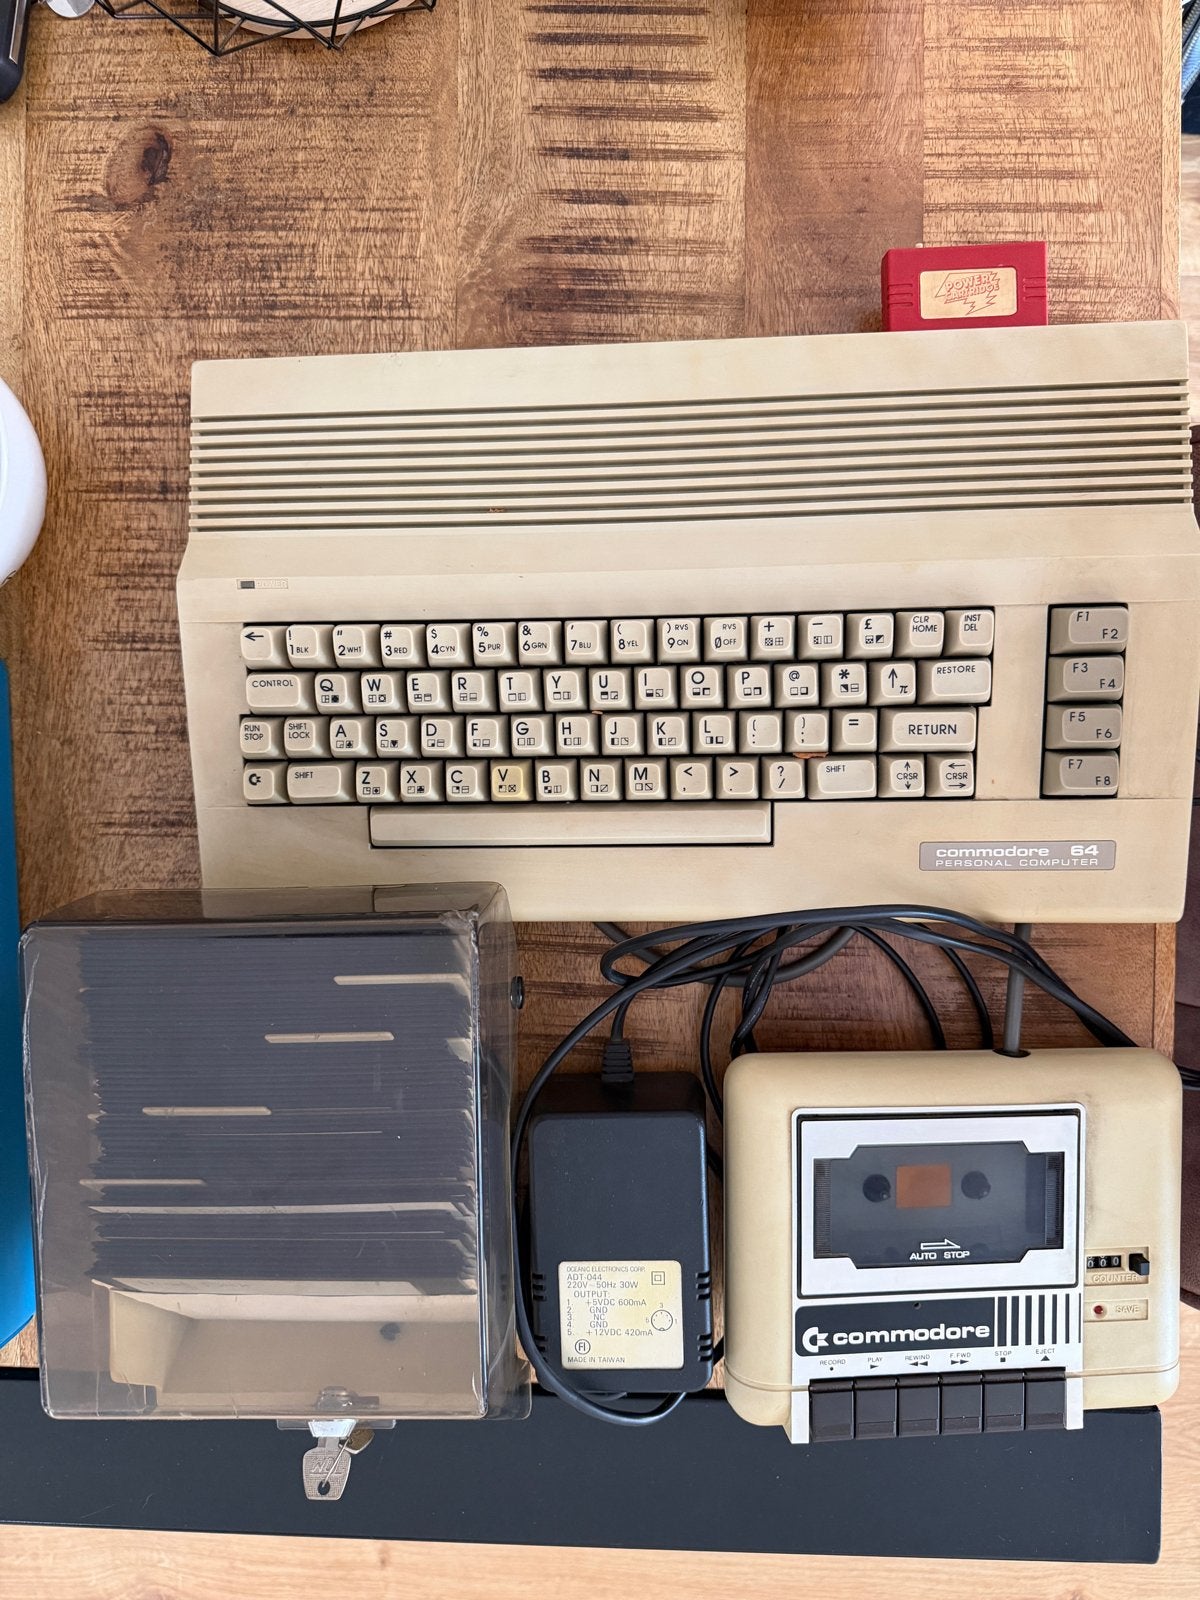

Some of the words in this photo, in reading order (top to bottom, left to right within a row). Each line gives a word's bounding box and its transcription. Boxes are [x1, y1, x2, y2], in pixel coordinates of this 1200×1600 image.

[945, 274, 990, 292] POWER
[913, 615, 930, 624] CLR
[964, 614, 981, 622] INST
[1076, 611, 1090, 622] F1
[674, 623, 689, 631] RVS
[722, 623, 737, 631] RVS
[864, 618, 872, 630] £
[912, 624, 938, 633] HOME
[964, 623, 978, 632] DEL
[383, 630, 393, 639] #
[431, 628, 438, 640] $
[477, 626, 489, 637] %
[522, 625, 532, 636] &
[1102, 628, 1119, 640] F2
[478, 642, 486, 653] 5
[487, 643, 501, 651] PUR
[522, 640, 531, 651] 6
[570, 640, 578, 651] 7
[579, 641, 592, 649] BLU
[618, 638, 626, 650] 8
[667, 637, 675, 648] 9
[723, 638, 737, 646] OFF
[289, 645, 294, 655] 1
[296, 646, 309, 654] BLK
[338, 645, 346, 656] 2
[346, 645, 362, 653] WHT
[385, 645, 393, 656] 3
[431, 644, 440, 655] 4
[936, 665, 976, 675] RESTORE
[1072, 662, 1089, 673] F3
[551, 675, 562, 688] Y
[598, 675, 608, 688] U
[691, 671, 705, 685] O
[741, 671, 750, 685] P
[788, 670, 801, 682] @
[251, 679, 294, 688] CONTROL
[319, 678, 334, 692] Q
[366, 678, 382, 691] W
[411, 678, 419, 691] E
[457, 677, 467, 690] R
[506, 677, 514, 690] T
[1099, 678, 1116, 689] F4
[1069, 711, 1086, 722] F5
[244, 724, 261, 733] RUN
[288, 722, 307, 731] SHIFT
[335, 724, 347, 738] A
[379, 723, 388, 737] S
[425, 723, 437, 737] D
[471, 722, 479, 736] F
[515, 721, 529, 735] G
[561, 721, 572, 735] H
[609, 721, 617, 735] J
[656, 721, 667, 735] K
[704, 720, 711, 733] L
[908, 724, 957, 736] RETURN
[244, 732, 264, 741] STOP
[288, 731, 310, 739] LOCK
[1096, 728, 1113, 739] F6
[825, 765, 846, 773] SHIFT
[1068, 759, 1083, 770] F7
[294, 771, 314, 779] SHIFT
[450, 769, 463, 784] C
[497, 768, 509, 782] V
[541, 770, 551, 783] B
[589, 768, 600, 782] N
[633, 767, 648, 780] M
[777, 765, 785, 777] ?
[896, 772, 919, 781] CRSR
[945, 772, 968, 780] CRSR
[361, 771, 371, 785] Z
[406, 770, 417, 784] X
[1095, 776, 1111, 786] F8
[936, 845, 1050, 858] commodore
[1070, 844, 1099, 856] 64
[935, 857, 1012, 867] PERSONAL
[1019, 857, 1098, 867] COMPUTER
[909, 1251, 937, 1260] AUTO
[943, 1250, 970, 1259] STOP
[1092, 1273, 1138, 1283] COUNTER
[619, 1281, 639, 1289] 30W
[589, 1306, 608, 1314] GND
[1115, 1305, 1140, 1313] SAVE
[593, 1313, 606, 1321] NC
[832, 1323, 990, 1345] commodore
[819, 1358, 846, 1366] RECORD
